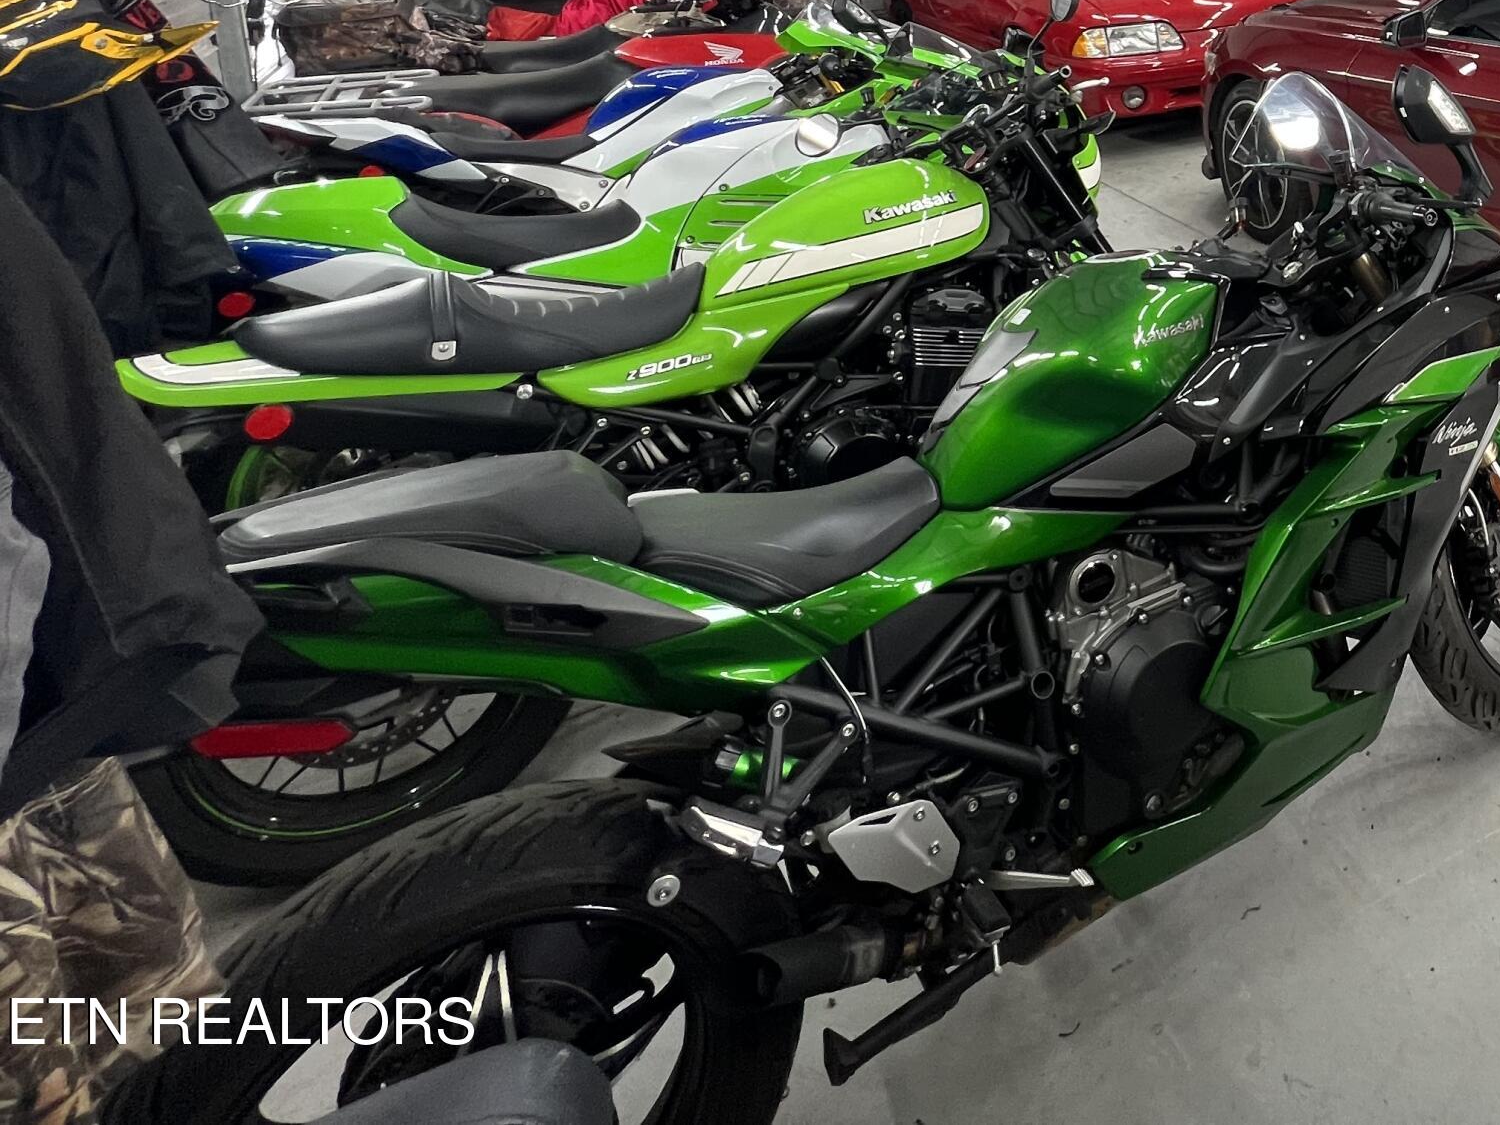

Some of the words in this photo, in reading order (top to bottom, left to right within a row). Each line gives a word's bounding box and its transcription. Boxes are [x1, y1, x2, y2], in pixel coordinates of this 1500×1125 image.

[704, 58, 744, 67] HONDA
[863, 190, 957, 225] Kawasaki
[1133, 313, 1205, 350] Kawasaki
[1431, 416, 1478, 447] Ninja
